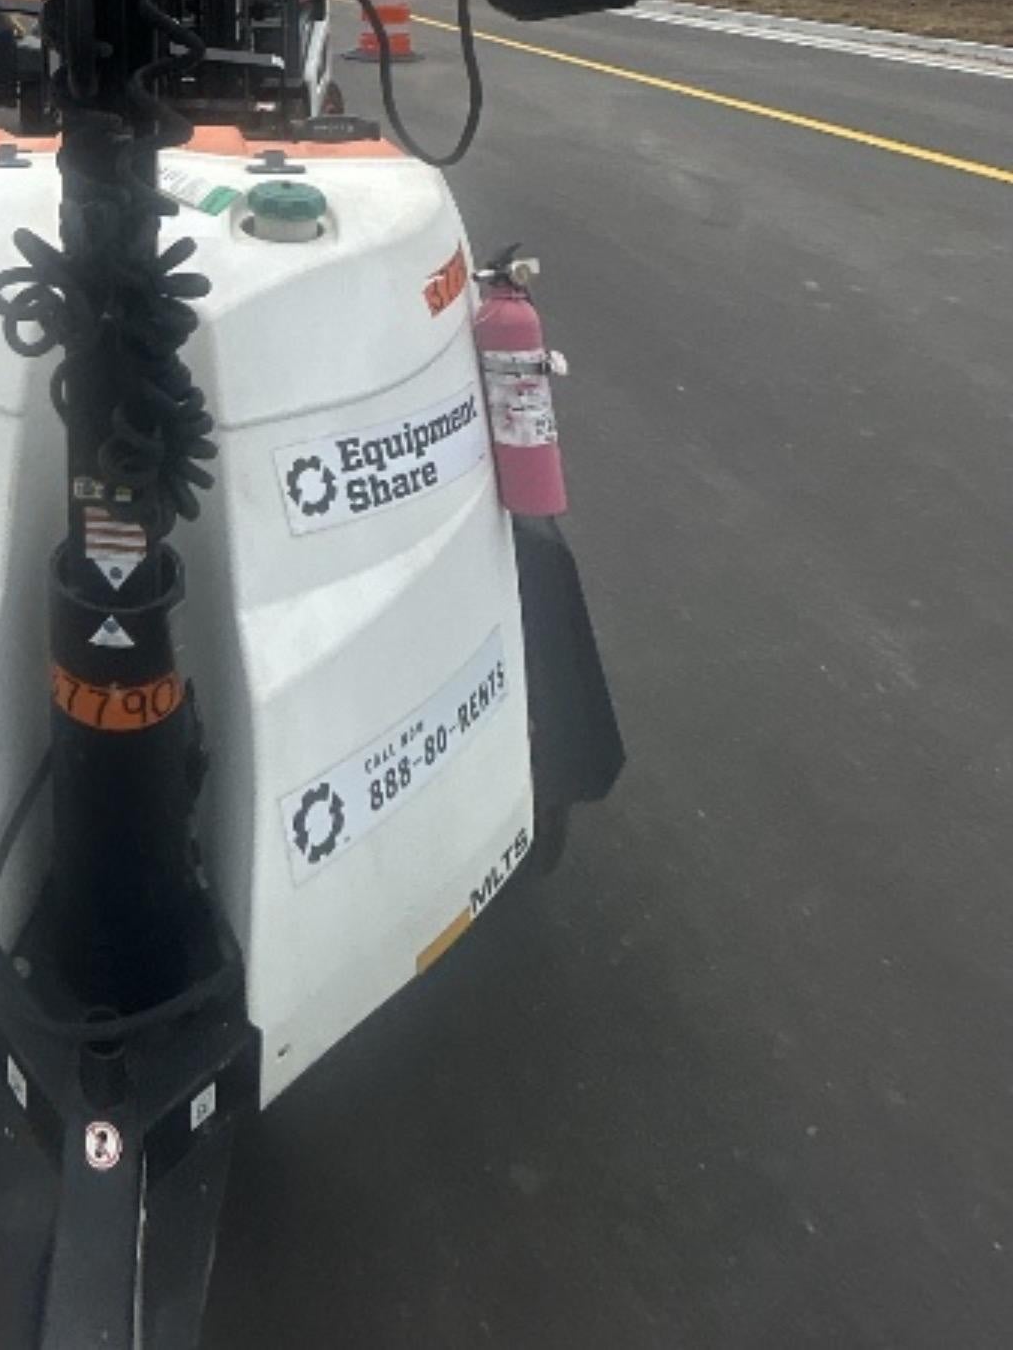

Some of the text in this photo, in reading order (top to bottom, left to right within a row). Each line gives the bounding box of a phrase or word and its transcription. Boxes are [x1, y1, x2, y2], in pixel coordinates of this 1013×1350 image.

[335, 394, 478, 473] Equipment
[346, 461, 438, 514] Share
[53, 673, 175, 727] 7790
[368, 659, 505, 811] 888-80-RENTS
